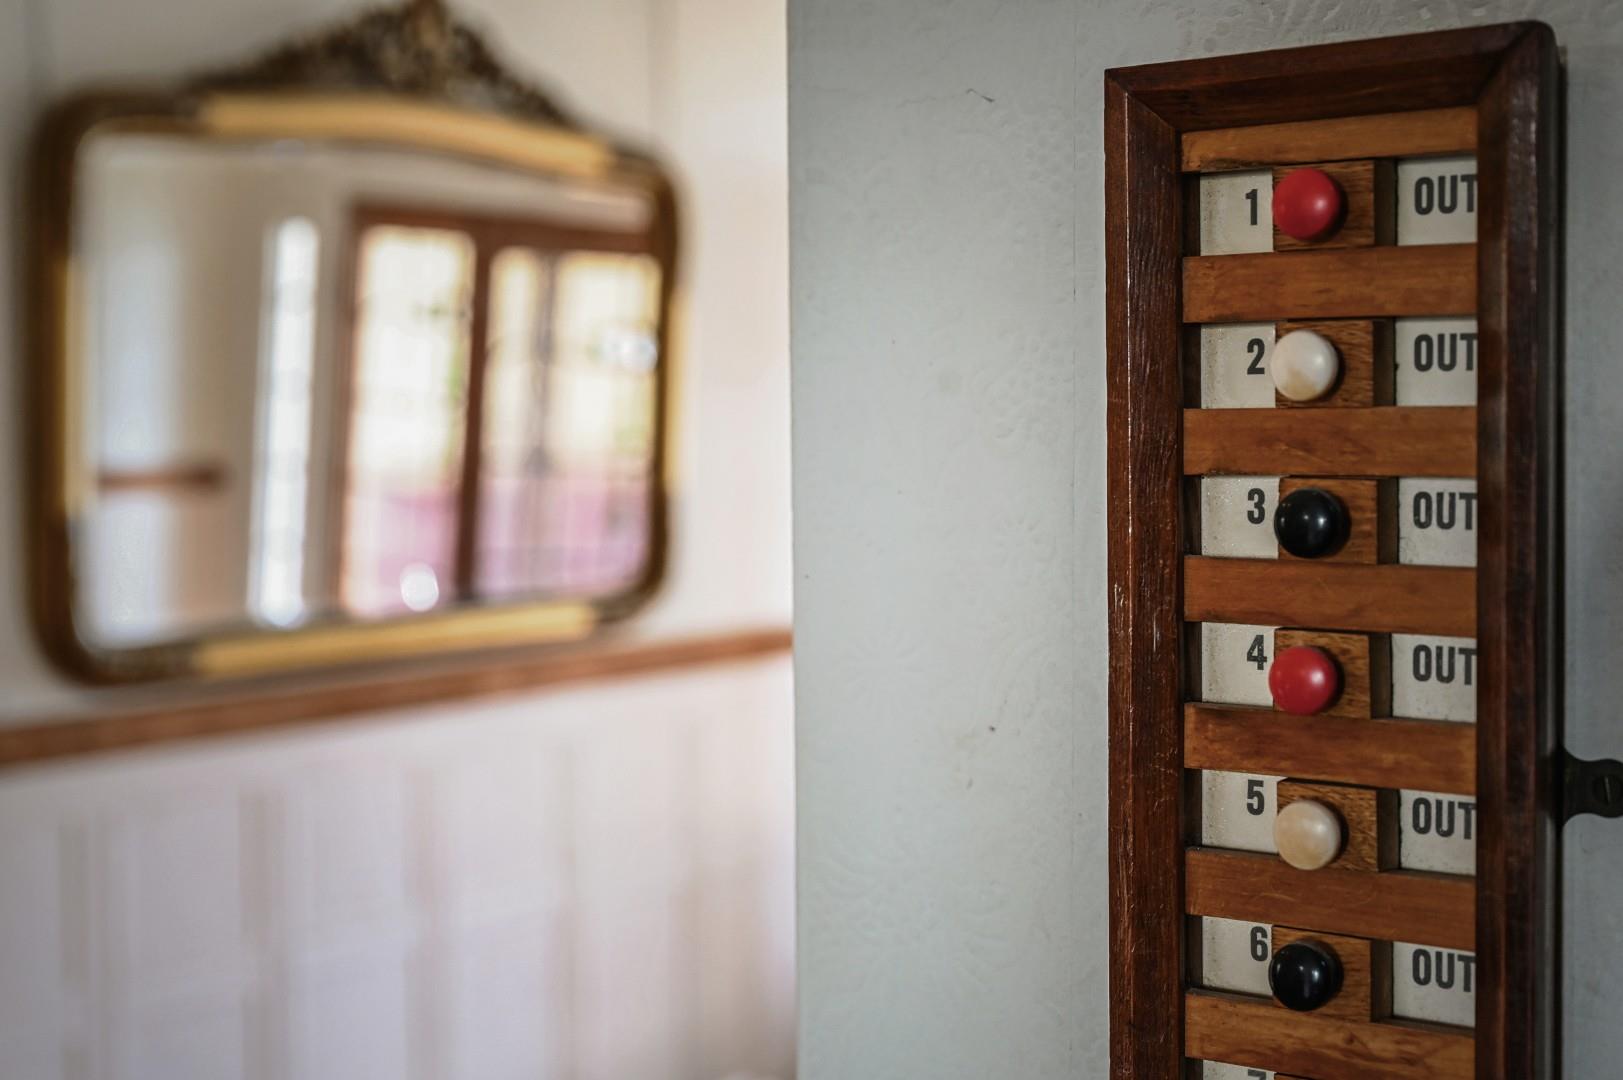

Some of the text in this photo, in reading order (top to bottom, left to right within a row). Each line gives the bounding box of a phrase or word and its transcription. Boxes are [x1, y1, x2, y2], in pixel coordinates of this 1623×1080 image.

[1245, 188, 1258, 226] 1
[1413, 174, 1477, 216] OUT
[1246, 338, 1266, 375] 2
[1413, 332, 1477, 373] OUT
[1246, 487, 1266, 525] 3
[1412, 490, 1477, 531] OUT
[1246, 634, 1268, 671] 4
[1412, 643, 1477, 686] OUT
[1246, 778, 1265, 816] 5
[1411, 796, 1477, 840] OUT
[1249, 926, 1269, 962] 6
[1411, 947, 1477, 993] OUT
